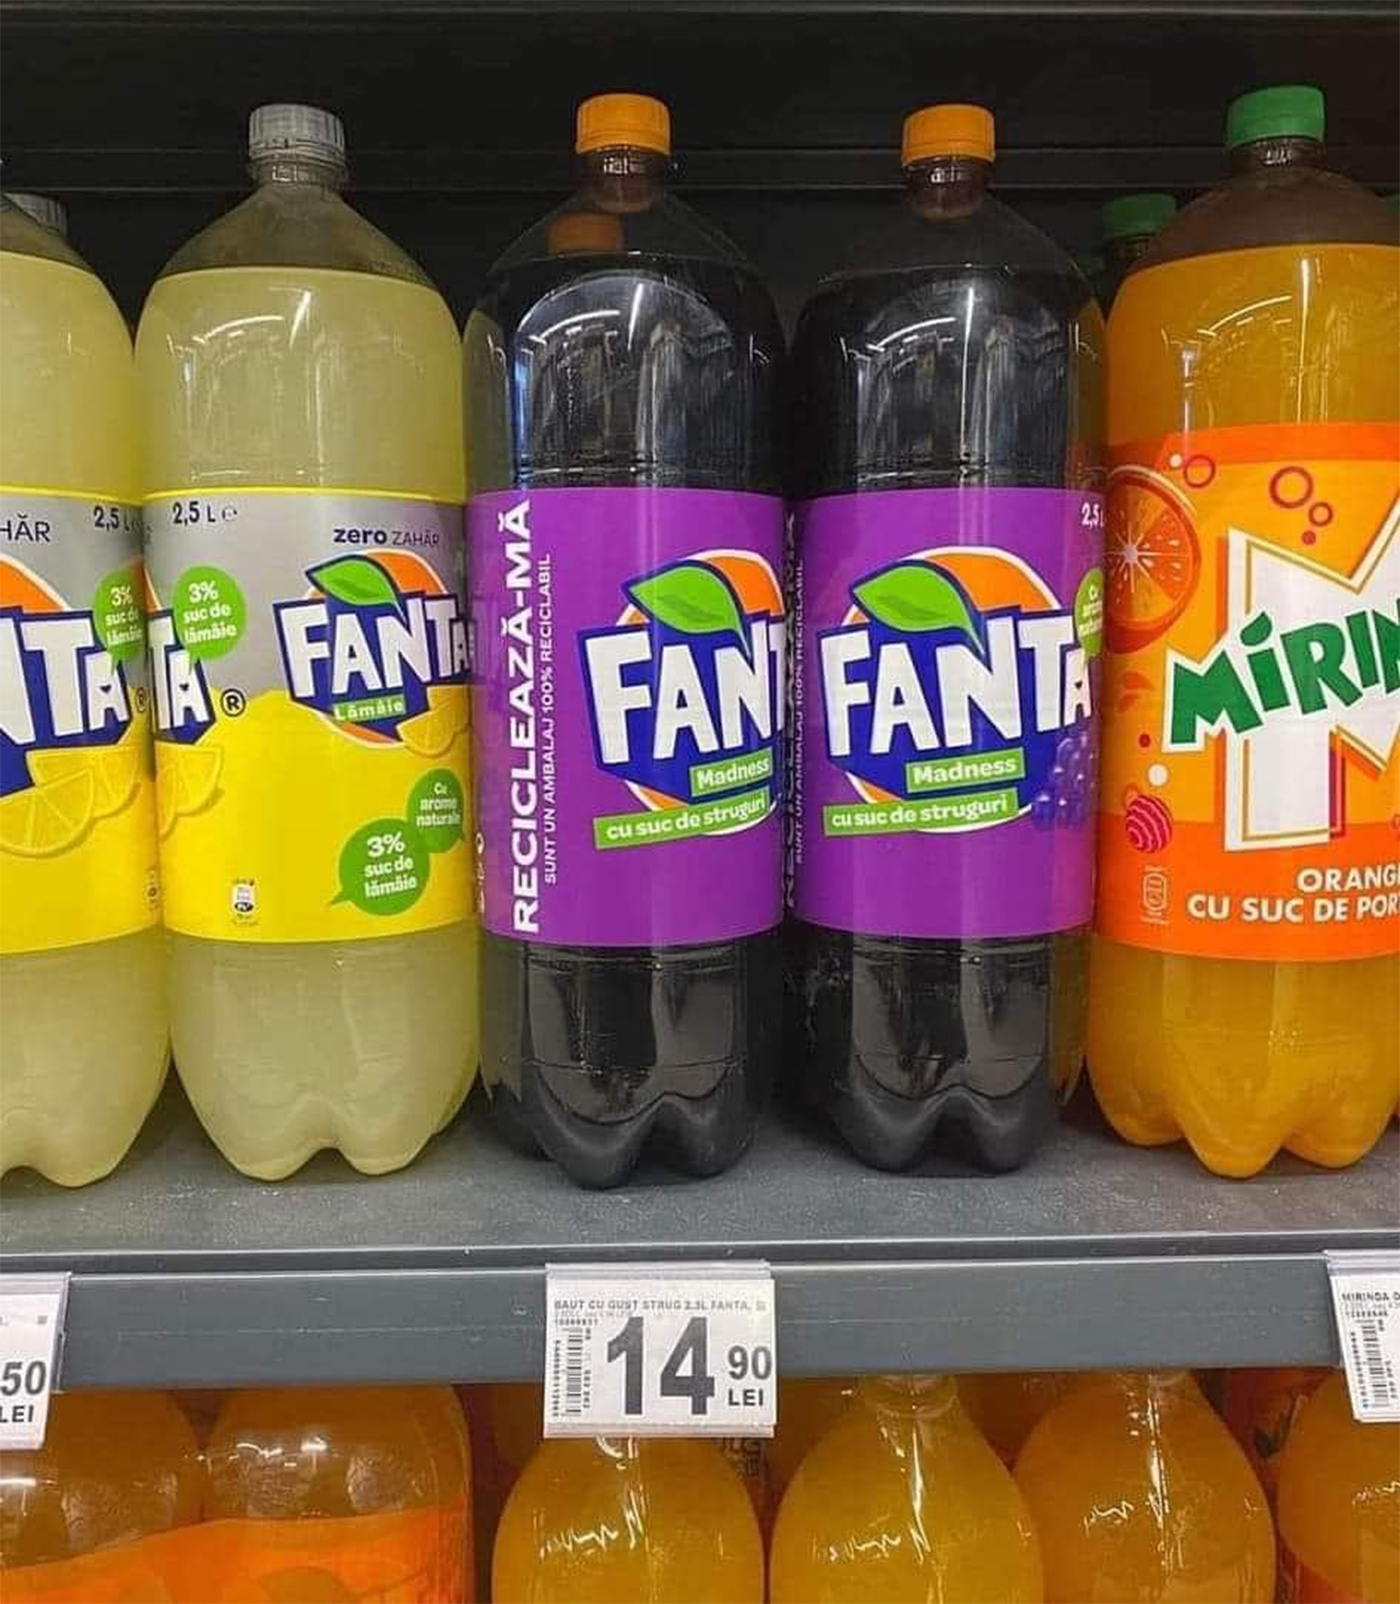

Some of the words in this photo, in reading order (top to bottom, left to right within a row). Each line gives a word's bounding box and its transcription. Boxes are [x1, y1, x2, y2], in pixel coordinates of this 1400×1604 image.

[172, 501, 201, 527] 2,5
[207, 506, 216, 523] L
[333, 527, 388, 545] zero
[188, 581, 219, 603] 3%
[538, 554, 553, 662] RECICLABIL
[183, 609, 208, 624] suc
[210, 602, 232, 618] de
[540, 664, 554, 714] 100%
[820, 614, 1093, 759] FANTA
[498, 499, 540, 936] RECICLEAZĂ-MĂ
[541, 716, 556, 804] AMBALAJ
[697, 756, 771, 789] Madness
[913, 757, 1018, 785] Madness
[543, 806, 556, 834] UN
[606, 825, 633, 840] cu
[635, 818, 673, 835] suc
[675, 811, 700, 831] de
[702, 791, 767, 823] struguri
[831, 813, 851, 827] cu
[853, 810, 888, 827] suc
[889, 803, 917, 823] de
[919, 793, 1008, 821] struguri
[366, 831, 406, 858] 3%
[543, 837, 558, 885] SUNT
[364, 863, 393, 878] suc
[394, 855, 414, 872] de
[1297, 863, 1400, 893] ORANG
[1187, 893, 1230, 920] CU
[1241, 897, 1305, 924] SUC
[1313, 897, 1350, 923] DE
[1356, 893, 1400, 921] POR
[0, 1360, 47, 1396] 50
[607, 1315, 716, 1416] 14
[727, 1345, 773, 1381] 90
[727, 1388, 764, 1407] LEI
